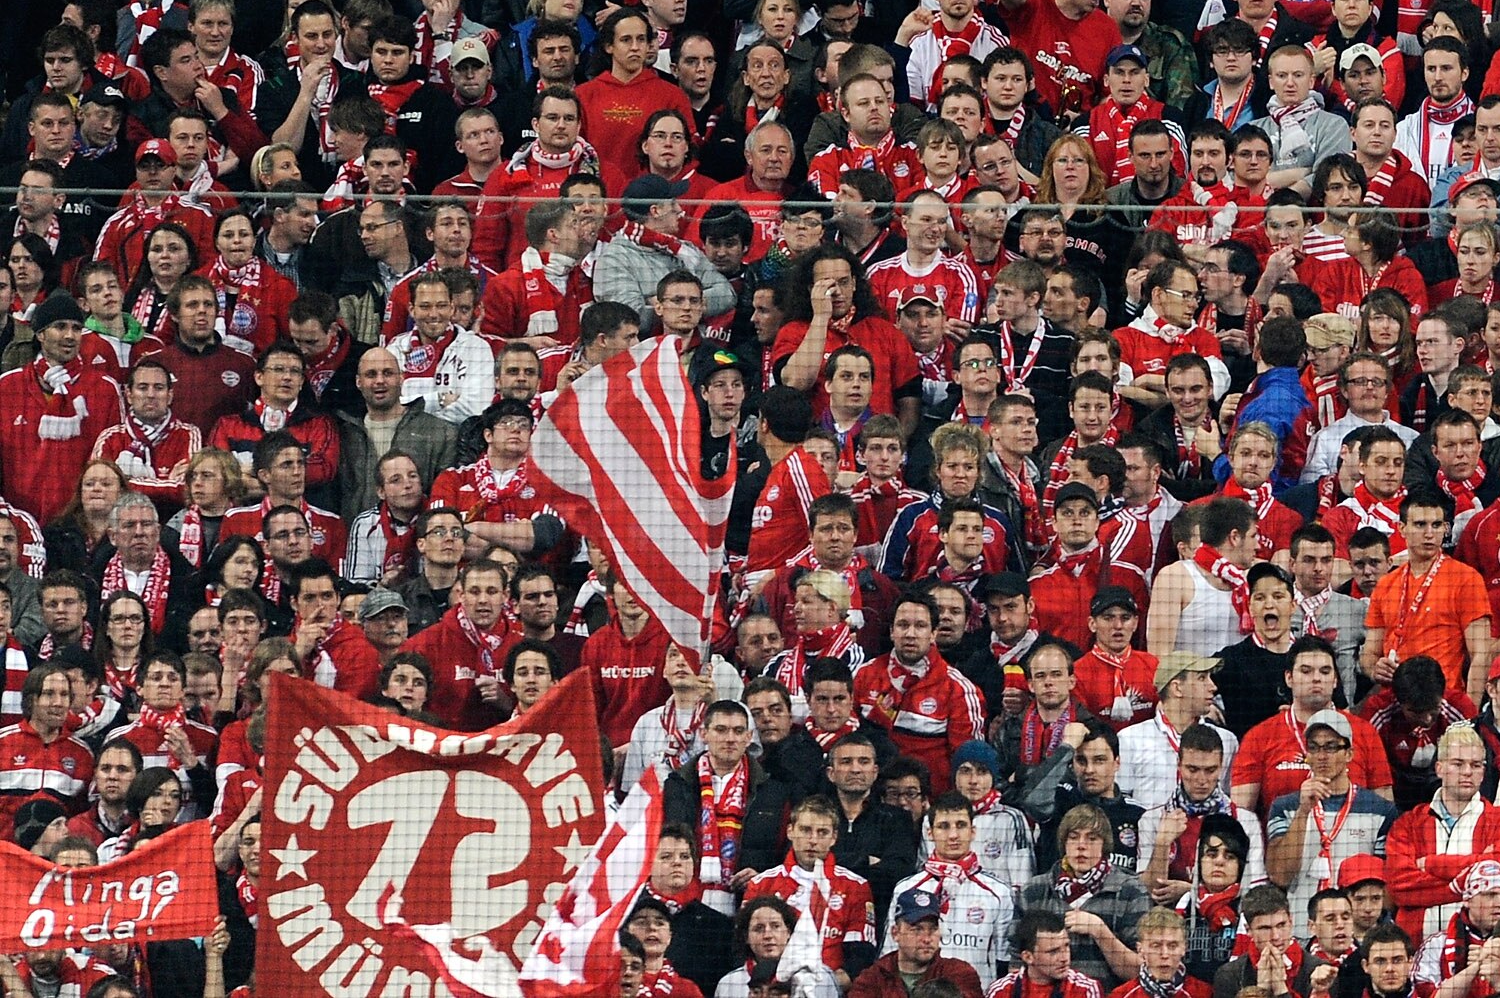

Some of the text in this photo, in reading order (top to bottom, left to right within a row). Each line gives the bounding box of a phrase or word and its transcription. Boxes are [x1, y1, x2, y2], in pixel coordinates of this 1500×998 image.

[345, 769, 531, 939] 72
[19, 896, 174, 947] Oida!
[28, 867, 180, 922] Minga
